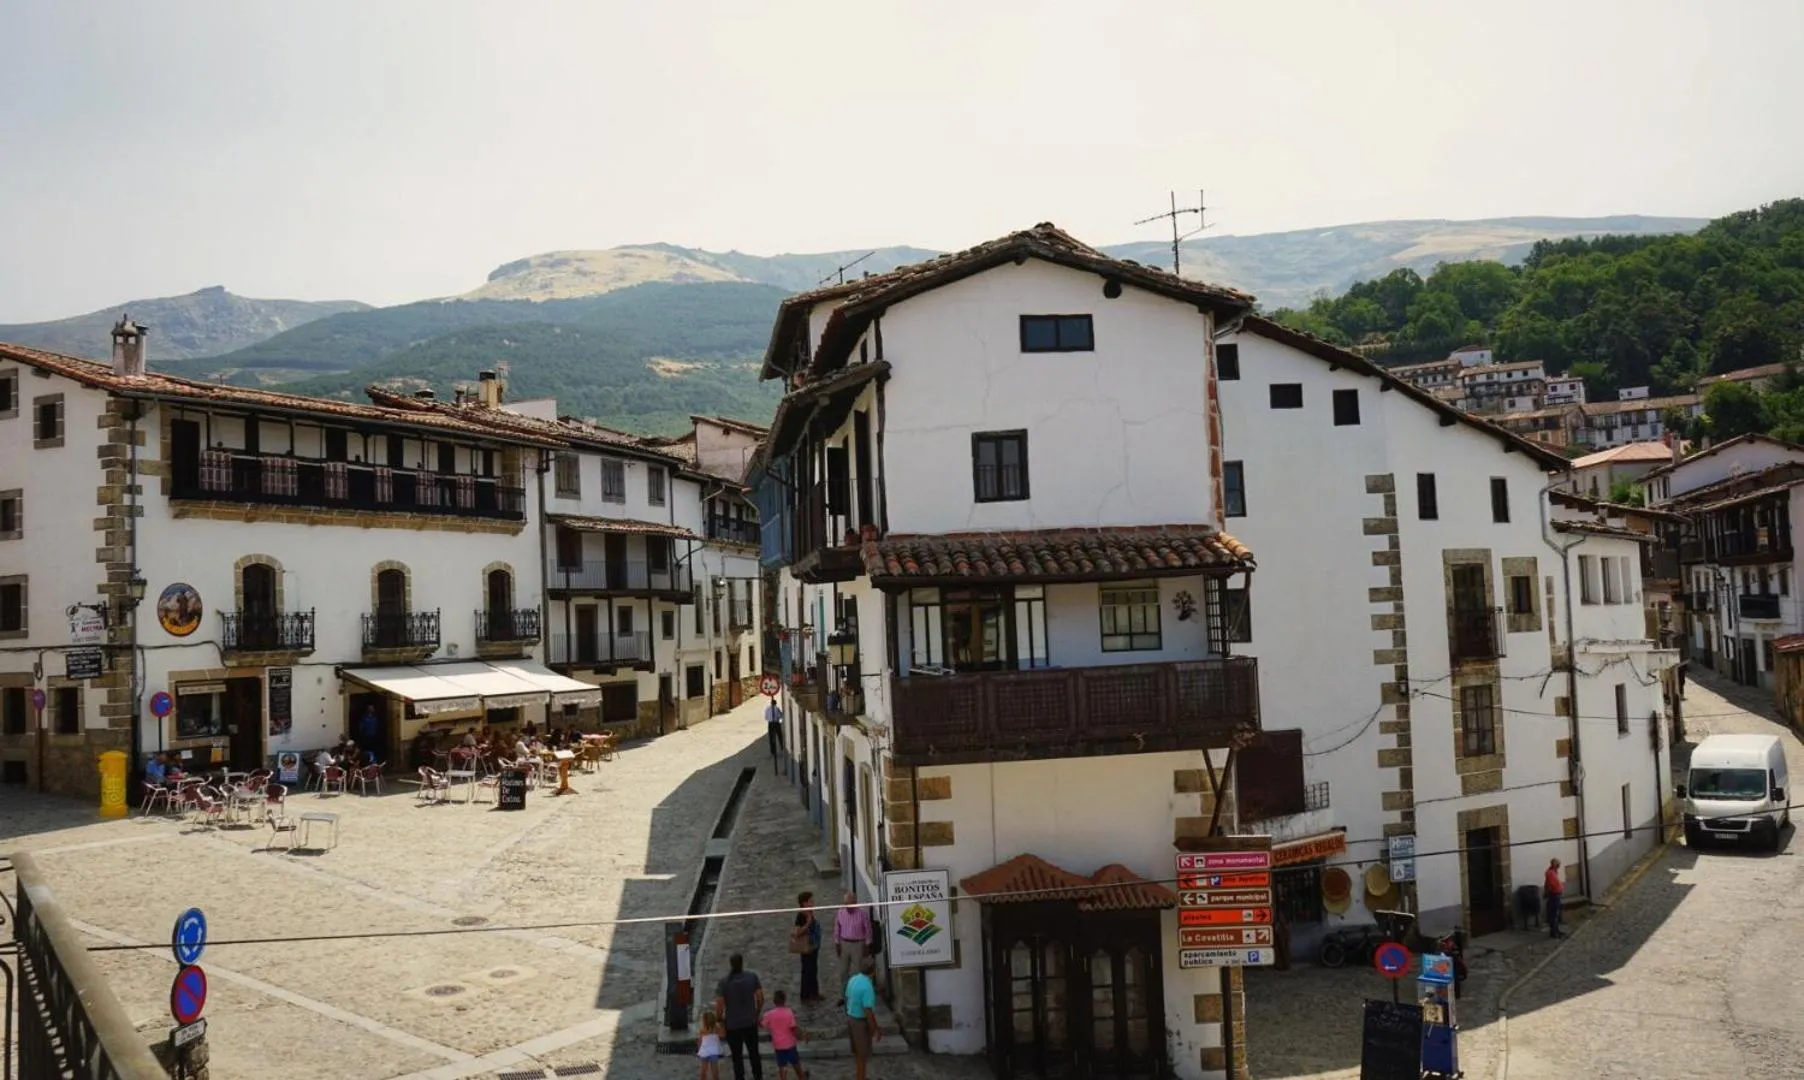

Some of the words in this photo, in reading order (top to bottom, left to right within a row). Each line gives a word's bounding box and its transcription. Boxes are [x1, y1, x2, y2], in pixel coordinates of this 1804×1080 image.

[894, 884, 940, 894] BONITOS
[908, 891, 944, 900] ESPAÑA
[1236, 894, 1266, 902] municipal
[1182, 934, 1192, 942] La
[1195, 933, 1235, 942] Covatilla
[1184, 951, 1237, 959] aparcamiento
